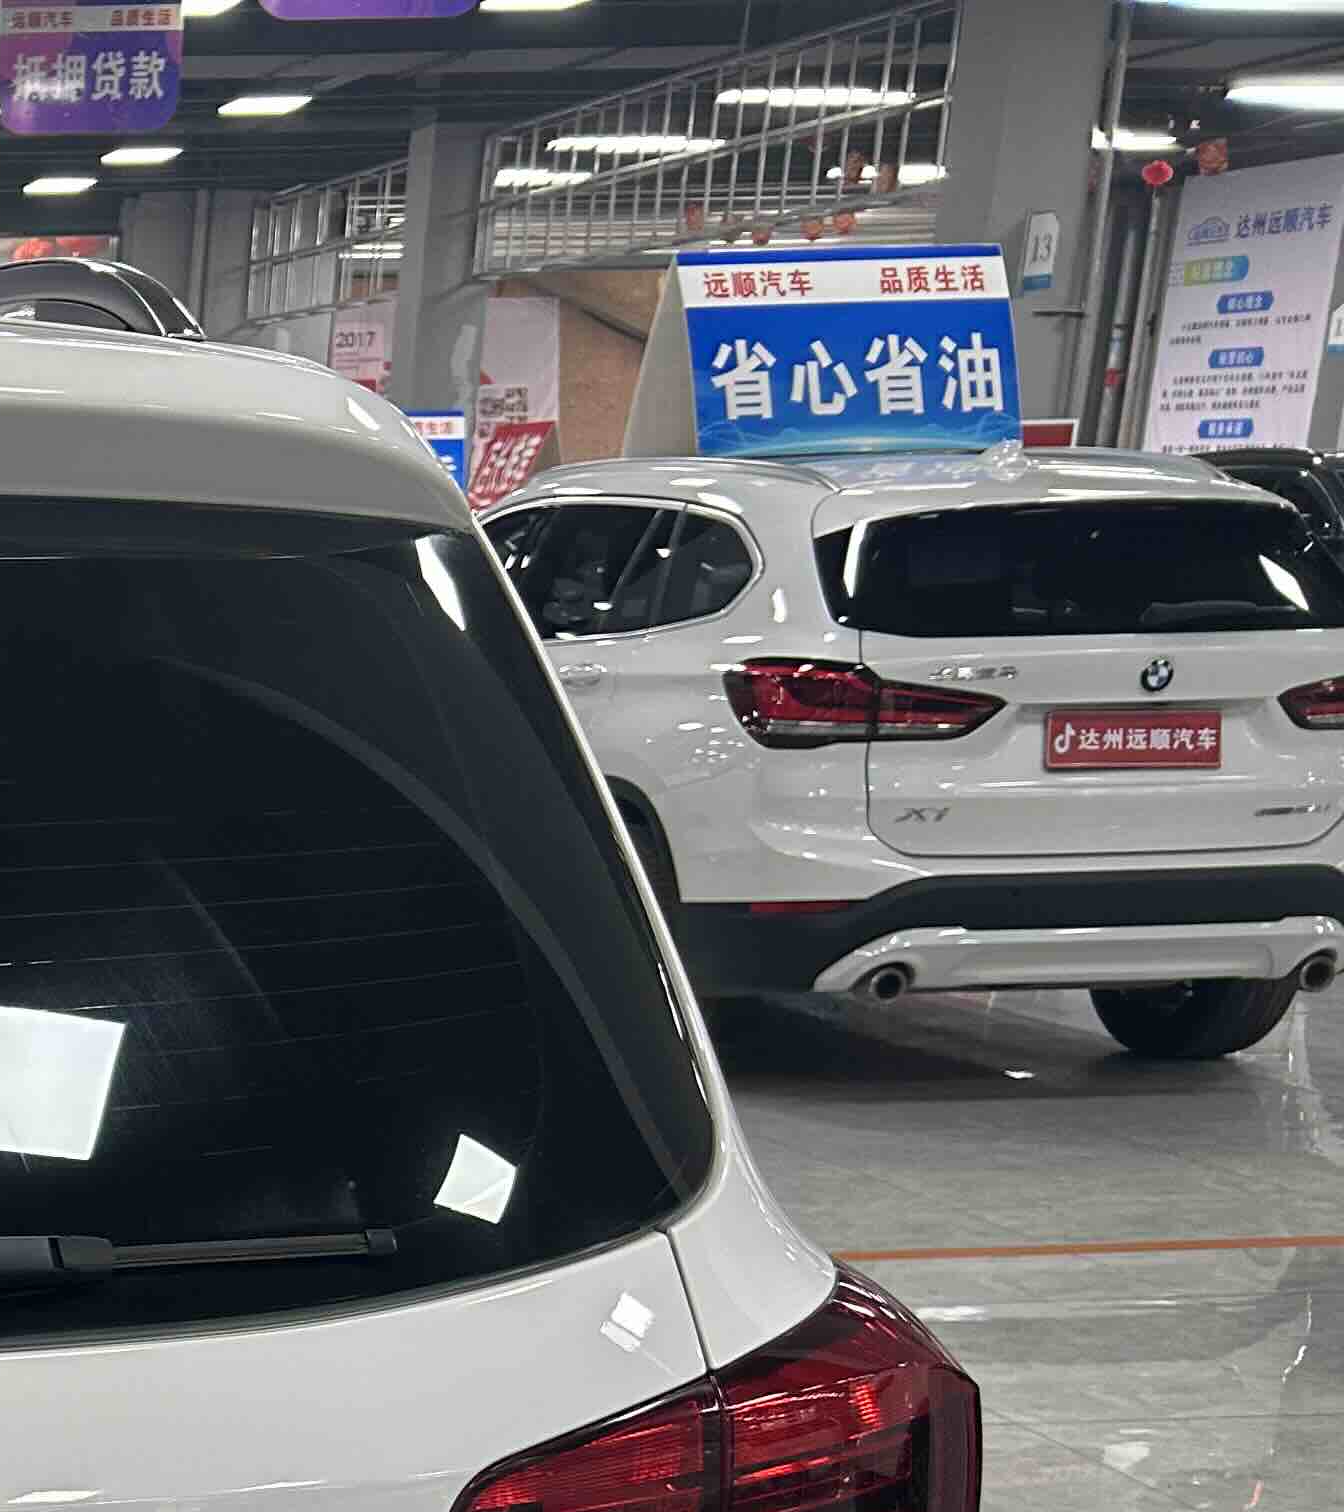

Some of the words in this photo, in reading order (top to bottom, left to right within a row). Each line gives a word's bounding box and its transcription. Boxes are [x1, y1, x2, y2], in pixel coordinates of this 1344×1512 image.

[10, 51, 165, 102] 抵押贷款
[703, 269, 813, 298] 远顺汽车
[879, 264, 985, 293] 品质生活
[335, 331, 376, 348] 2017
[711, 332, 1004, 420] 省心省油
[1078, 726, 1217, 751] 达州远顺汽车
[895, 807, 950, 823] X1
